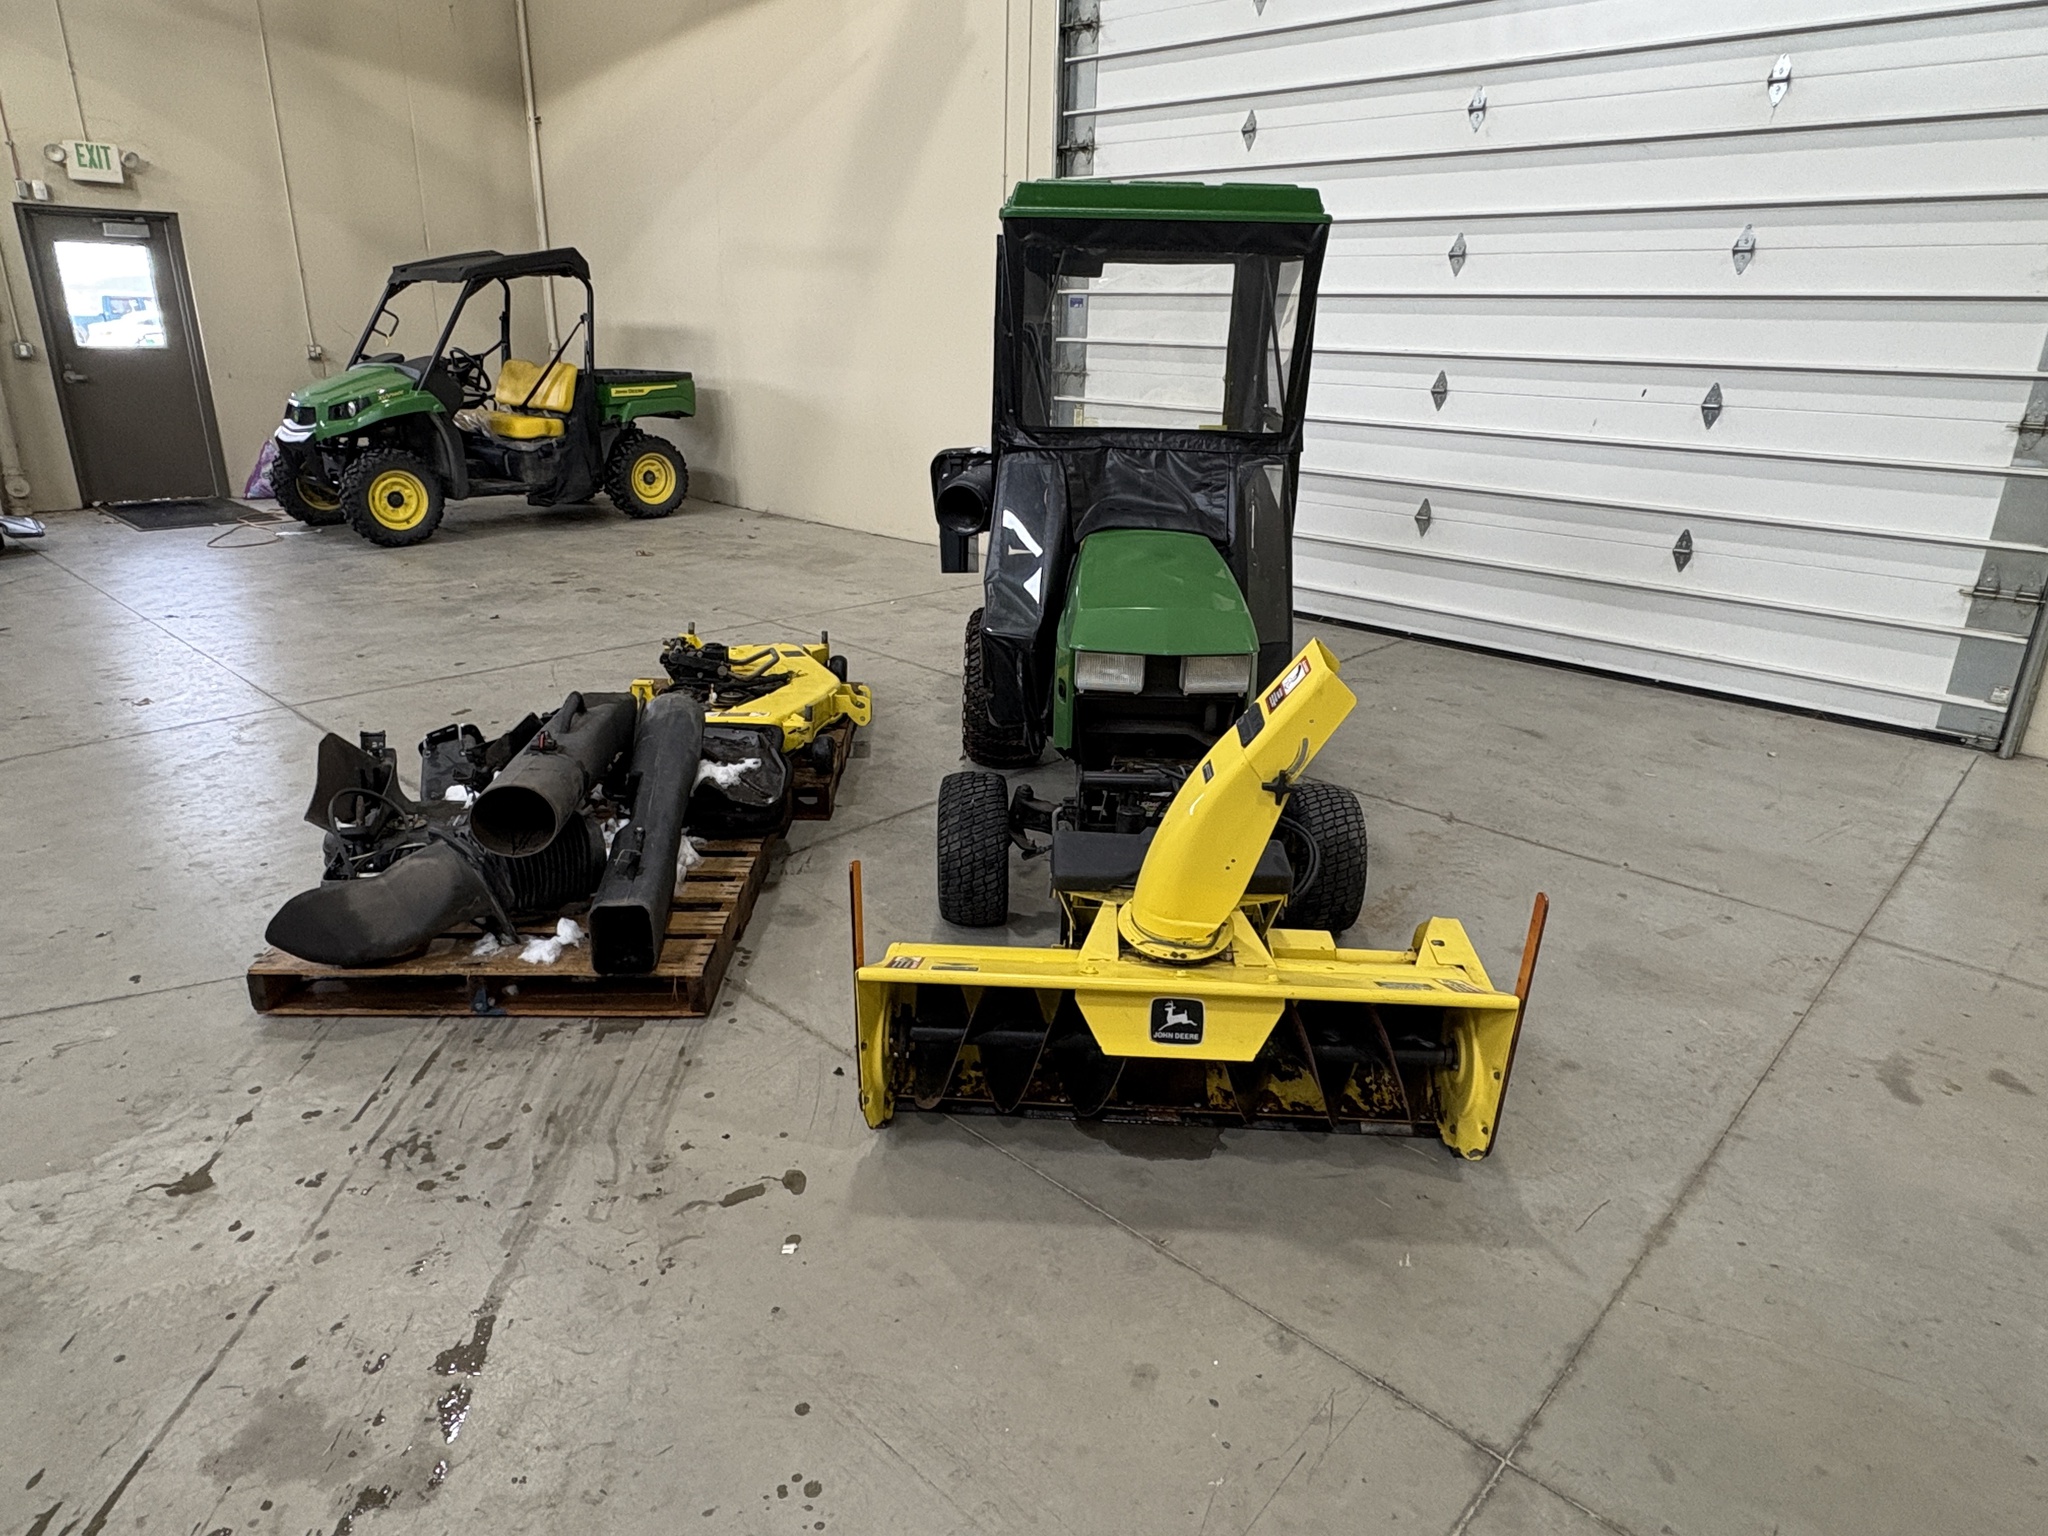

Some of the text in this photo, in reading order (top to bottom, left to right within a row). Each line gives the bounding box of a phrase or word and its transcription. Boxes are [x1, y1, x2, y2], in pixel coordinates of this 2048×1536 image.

[75, 143, 111, 170] EXIT
[1153, 1031, 1200, 1041] JOHN DEERE
